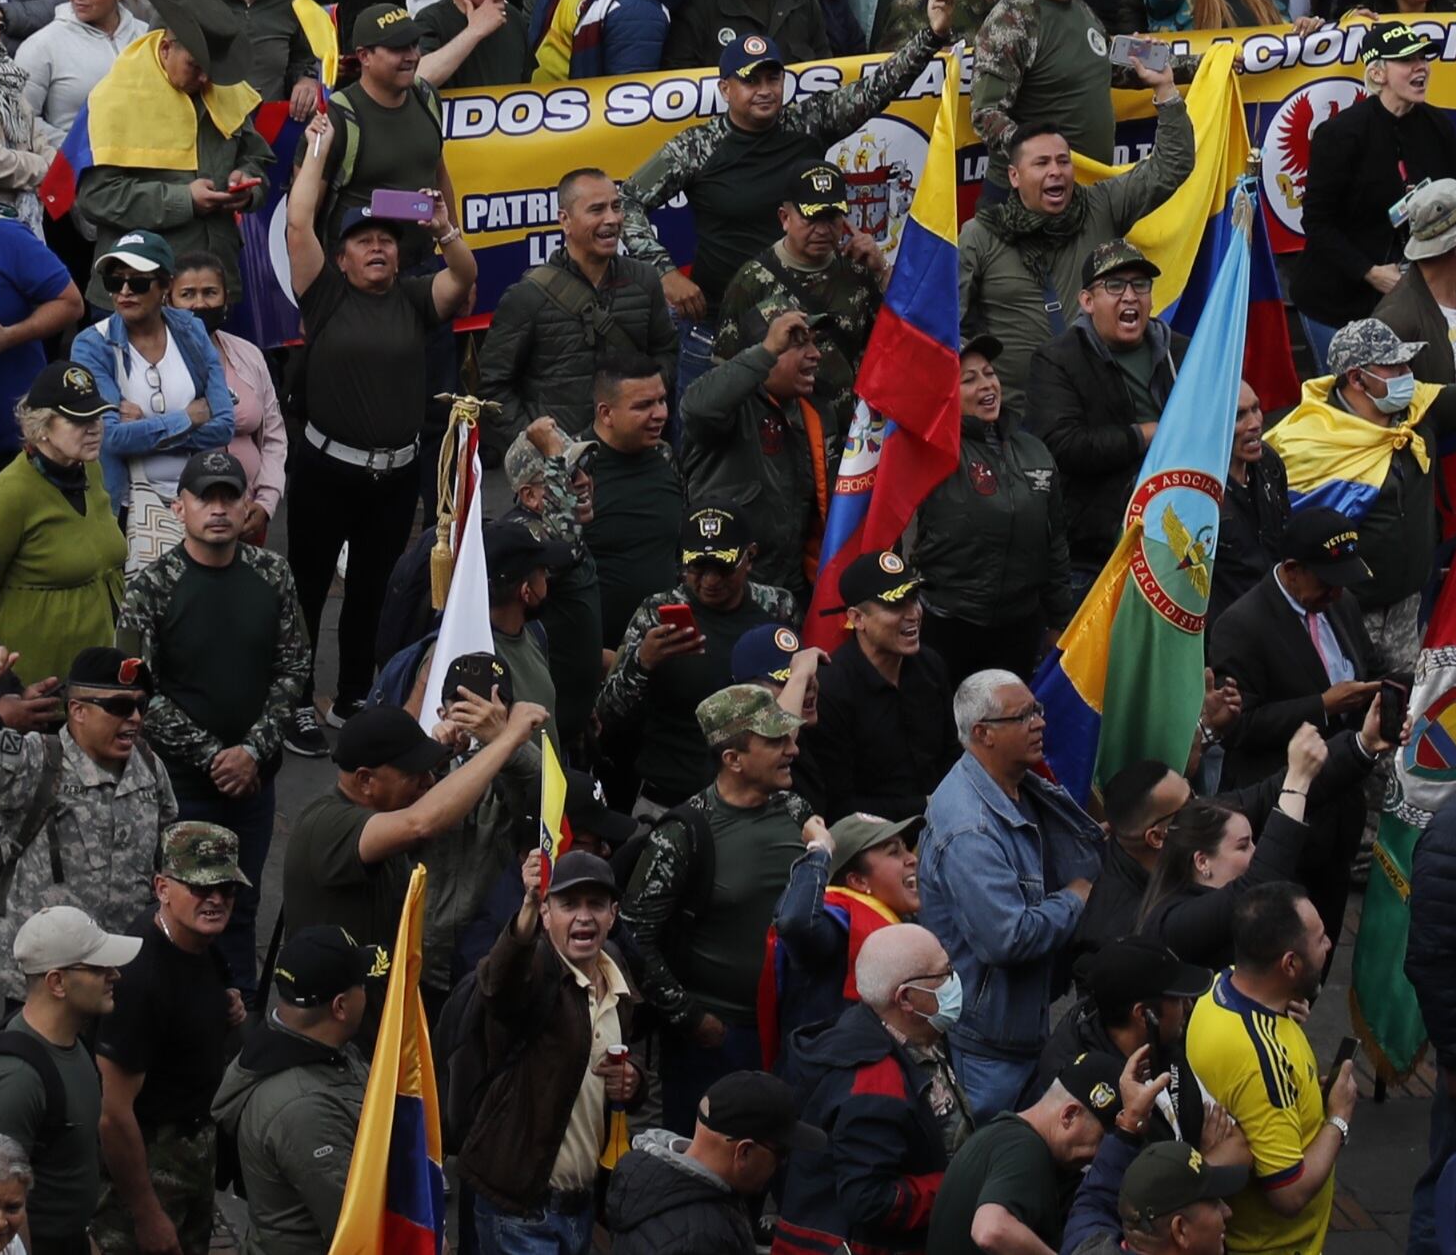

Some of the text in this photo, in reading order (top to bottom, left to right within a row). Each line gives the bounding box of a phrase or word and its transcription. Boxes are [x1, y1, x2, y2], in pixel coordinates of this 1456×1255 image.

[1161, 473, 1224, 503] ASOCIAC
[1322, 531, 1359, 550] VETERAN
[1133, 548, 1206, 630] ARACAIDISTAS
